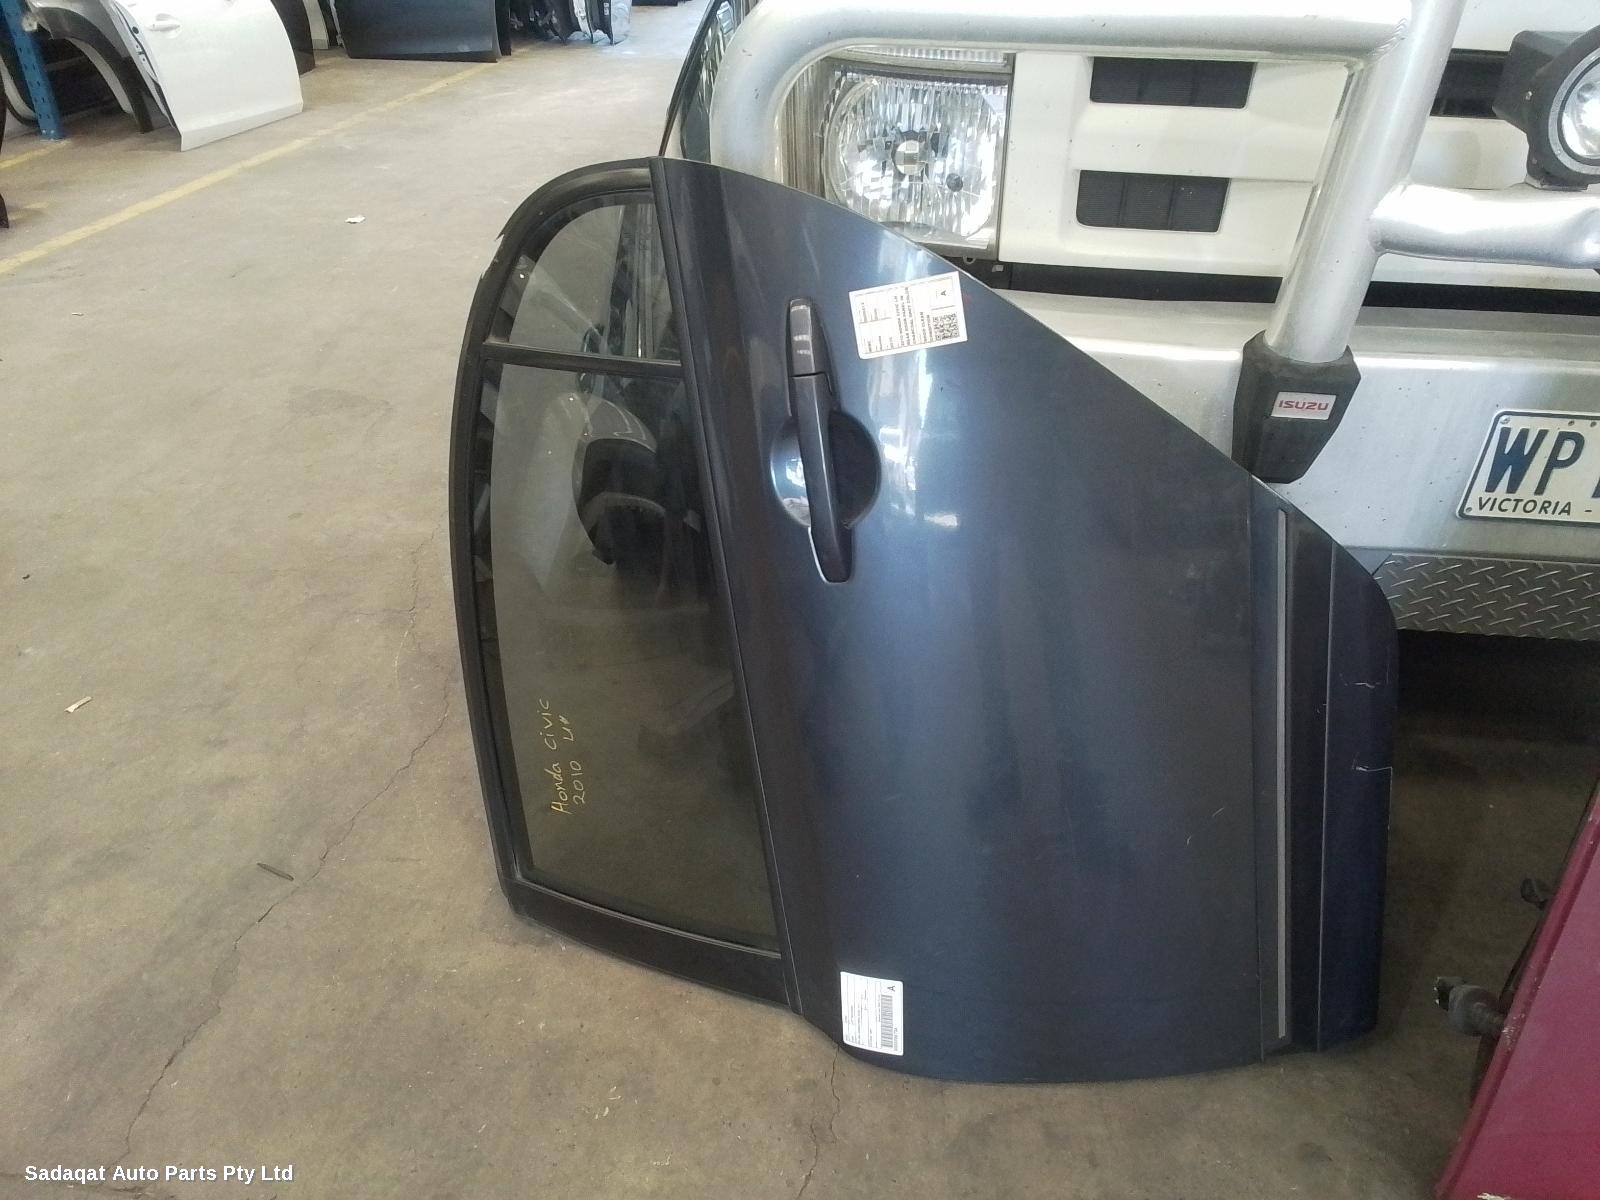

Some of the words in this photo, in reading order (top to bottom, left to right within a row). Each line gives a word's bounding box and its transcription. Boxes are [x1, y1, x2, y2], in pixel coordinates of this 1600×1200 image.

[1278, 400, 1329, 411] ISUZU
[1484, 426, 1600, 498] WP
[1478, 496, 1572, 515] VICTORIA
[544, 762, 573, 815] Honda
[569, 760, 585, 805] 2010
